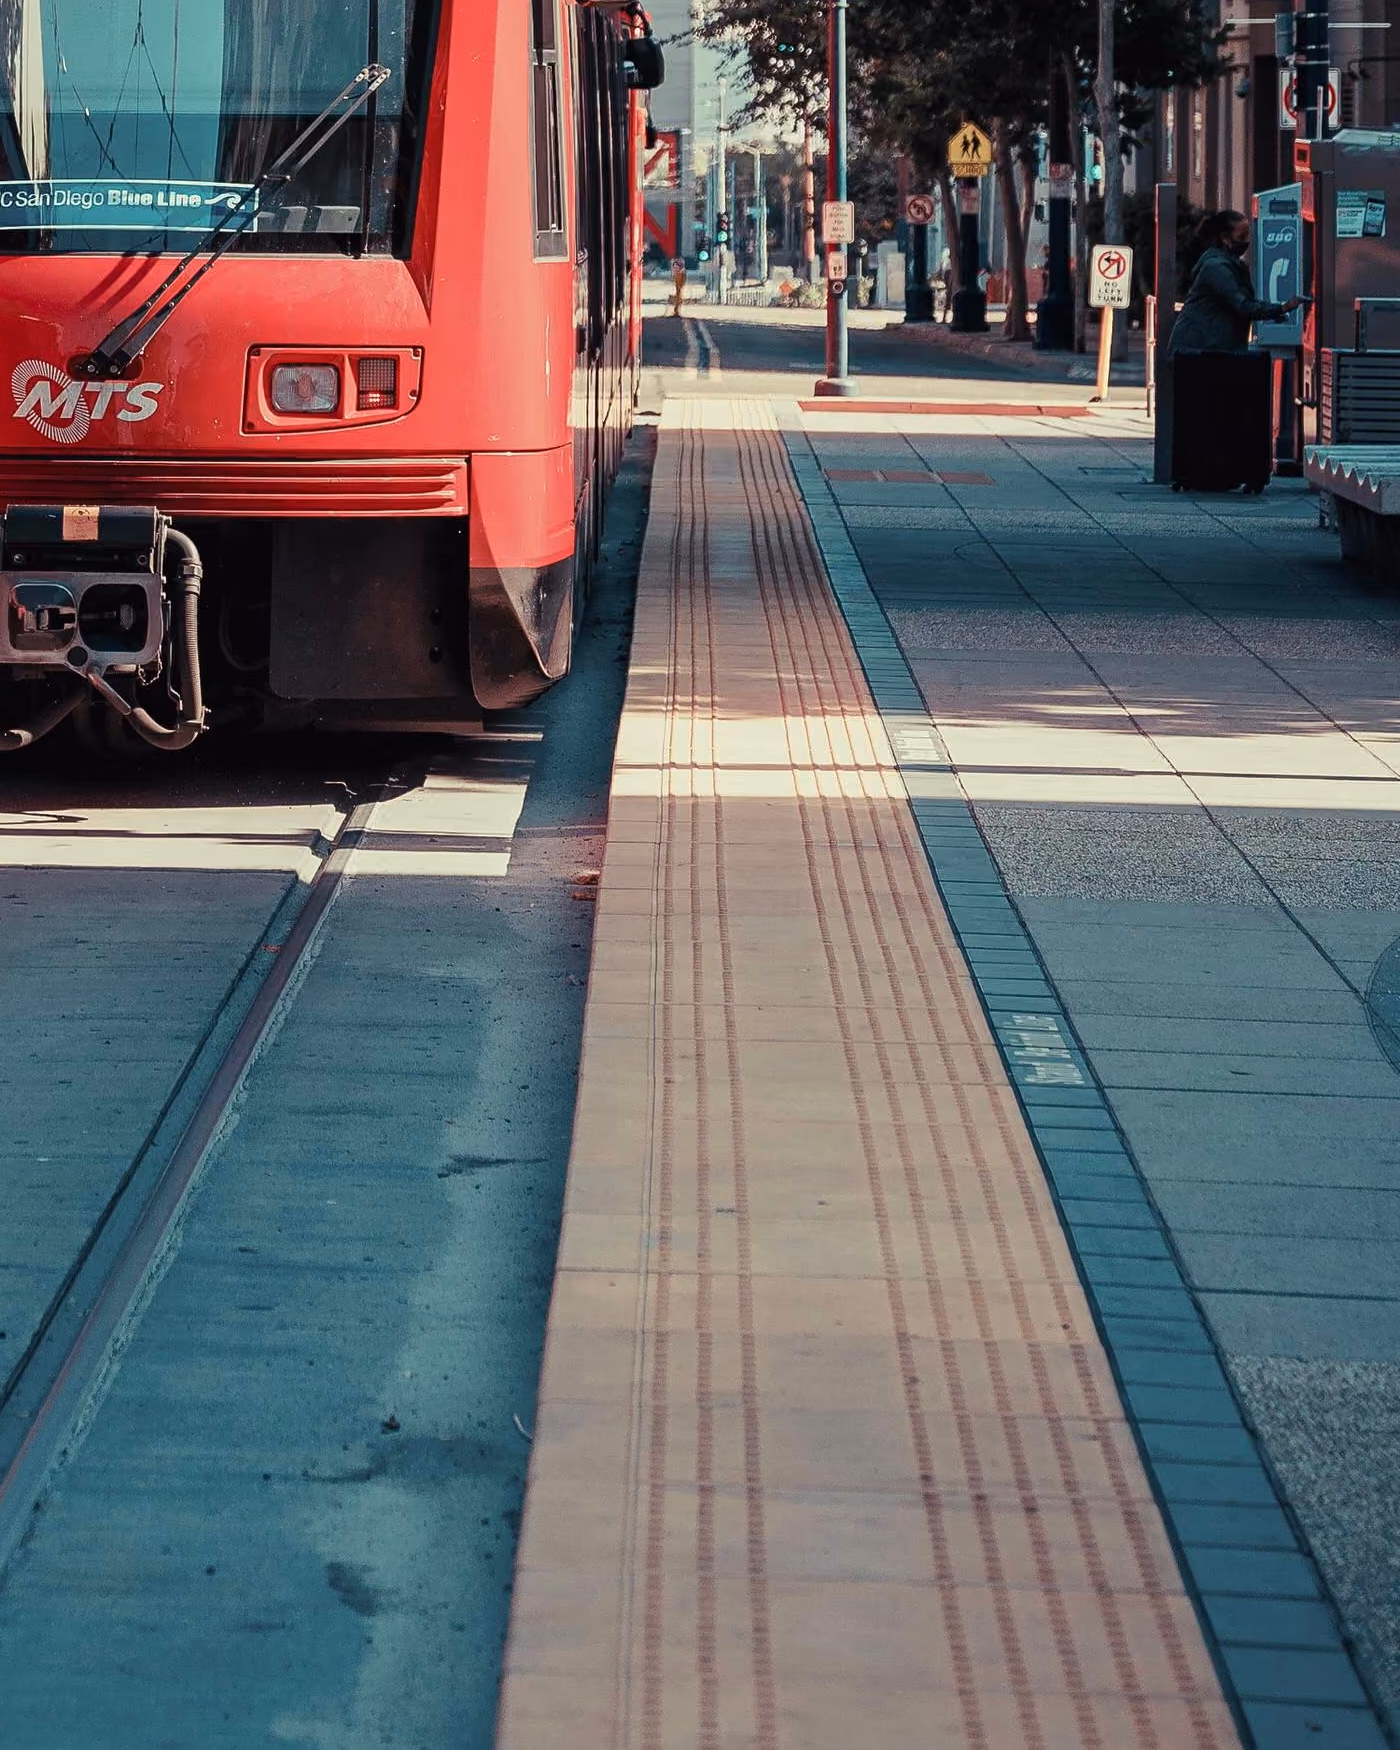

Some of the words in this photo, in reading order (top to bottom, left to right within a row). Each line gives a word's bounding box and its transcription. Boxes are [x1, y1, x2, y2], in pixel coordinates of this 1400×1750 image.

[15, 190, 50, 207] San
[53, 190, 104, 210] Diego
[107, 189, 153, 206] Blue
[157, 190, 202, 208] Line
[1097, 295, 1123, 303] TURN
[12, 380, 165, 422] MTS
